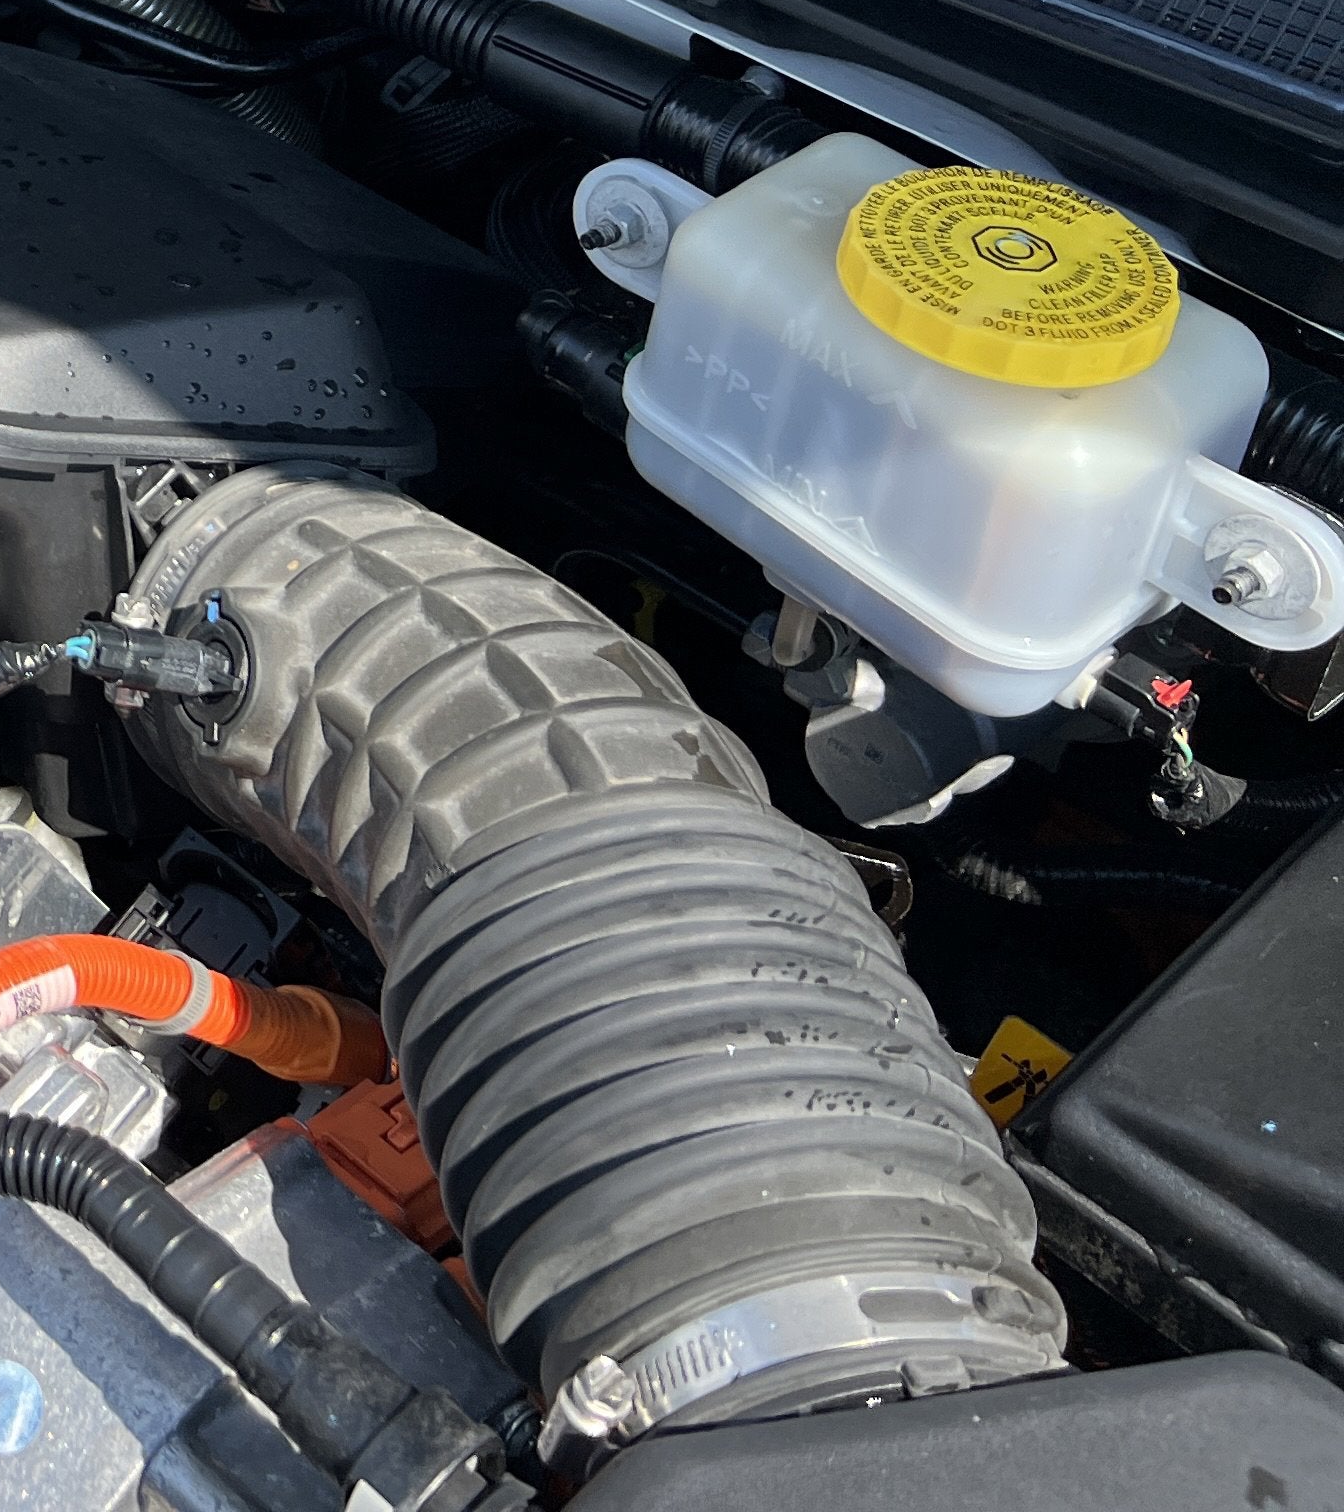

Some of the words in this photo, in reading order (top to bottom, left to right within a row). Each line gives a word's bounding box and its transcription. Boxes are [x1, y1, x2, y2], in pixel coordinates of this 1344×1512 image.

[1110, 238, 1142, 265] ONLY
[1125, 226, 1173, 284] CONTAINER
[1099, 252, 1121, 274] CAP
[1038, 261, 1096, 296] WARNING
[1127, 268, 1146, 287] USE
[1082, 274, 1118, 304] FILLER
[1028, 295, 1085, 310] CLEAN
[1138, 285, 1172, 320] SEALED
[982, 316, 1019, 334] DOT
[1001, 308, 1076, 326] BEFORE
[1024, 326, 1036, 337] 3
[1039, 327, 1090, 339] FLUID
[1090, 319, 1133, 338] FROM
